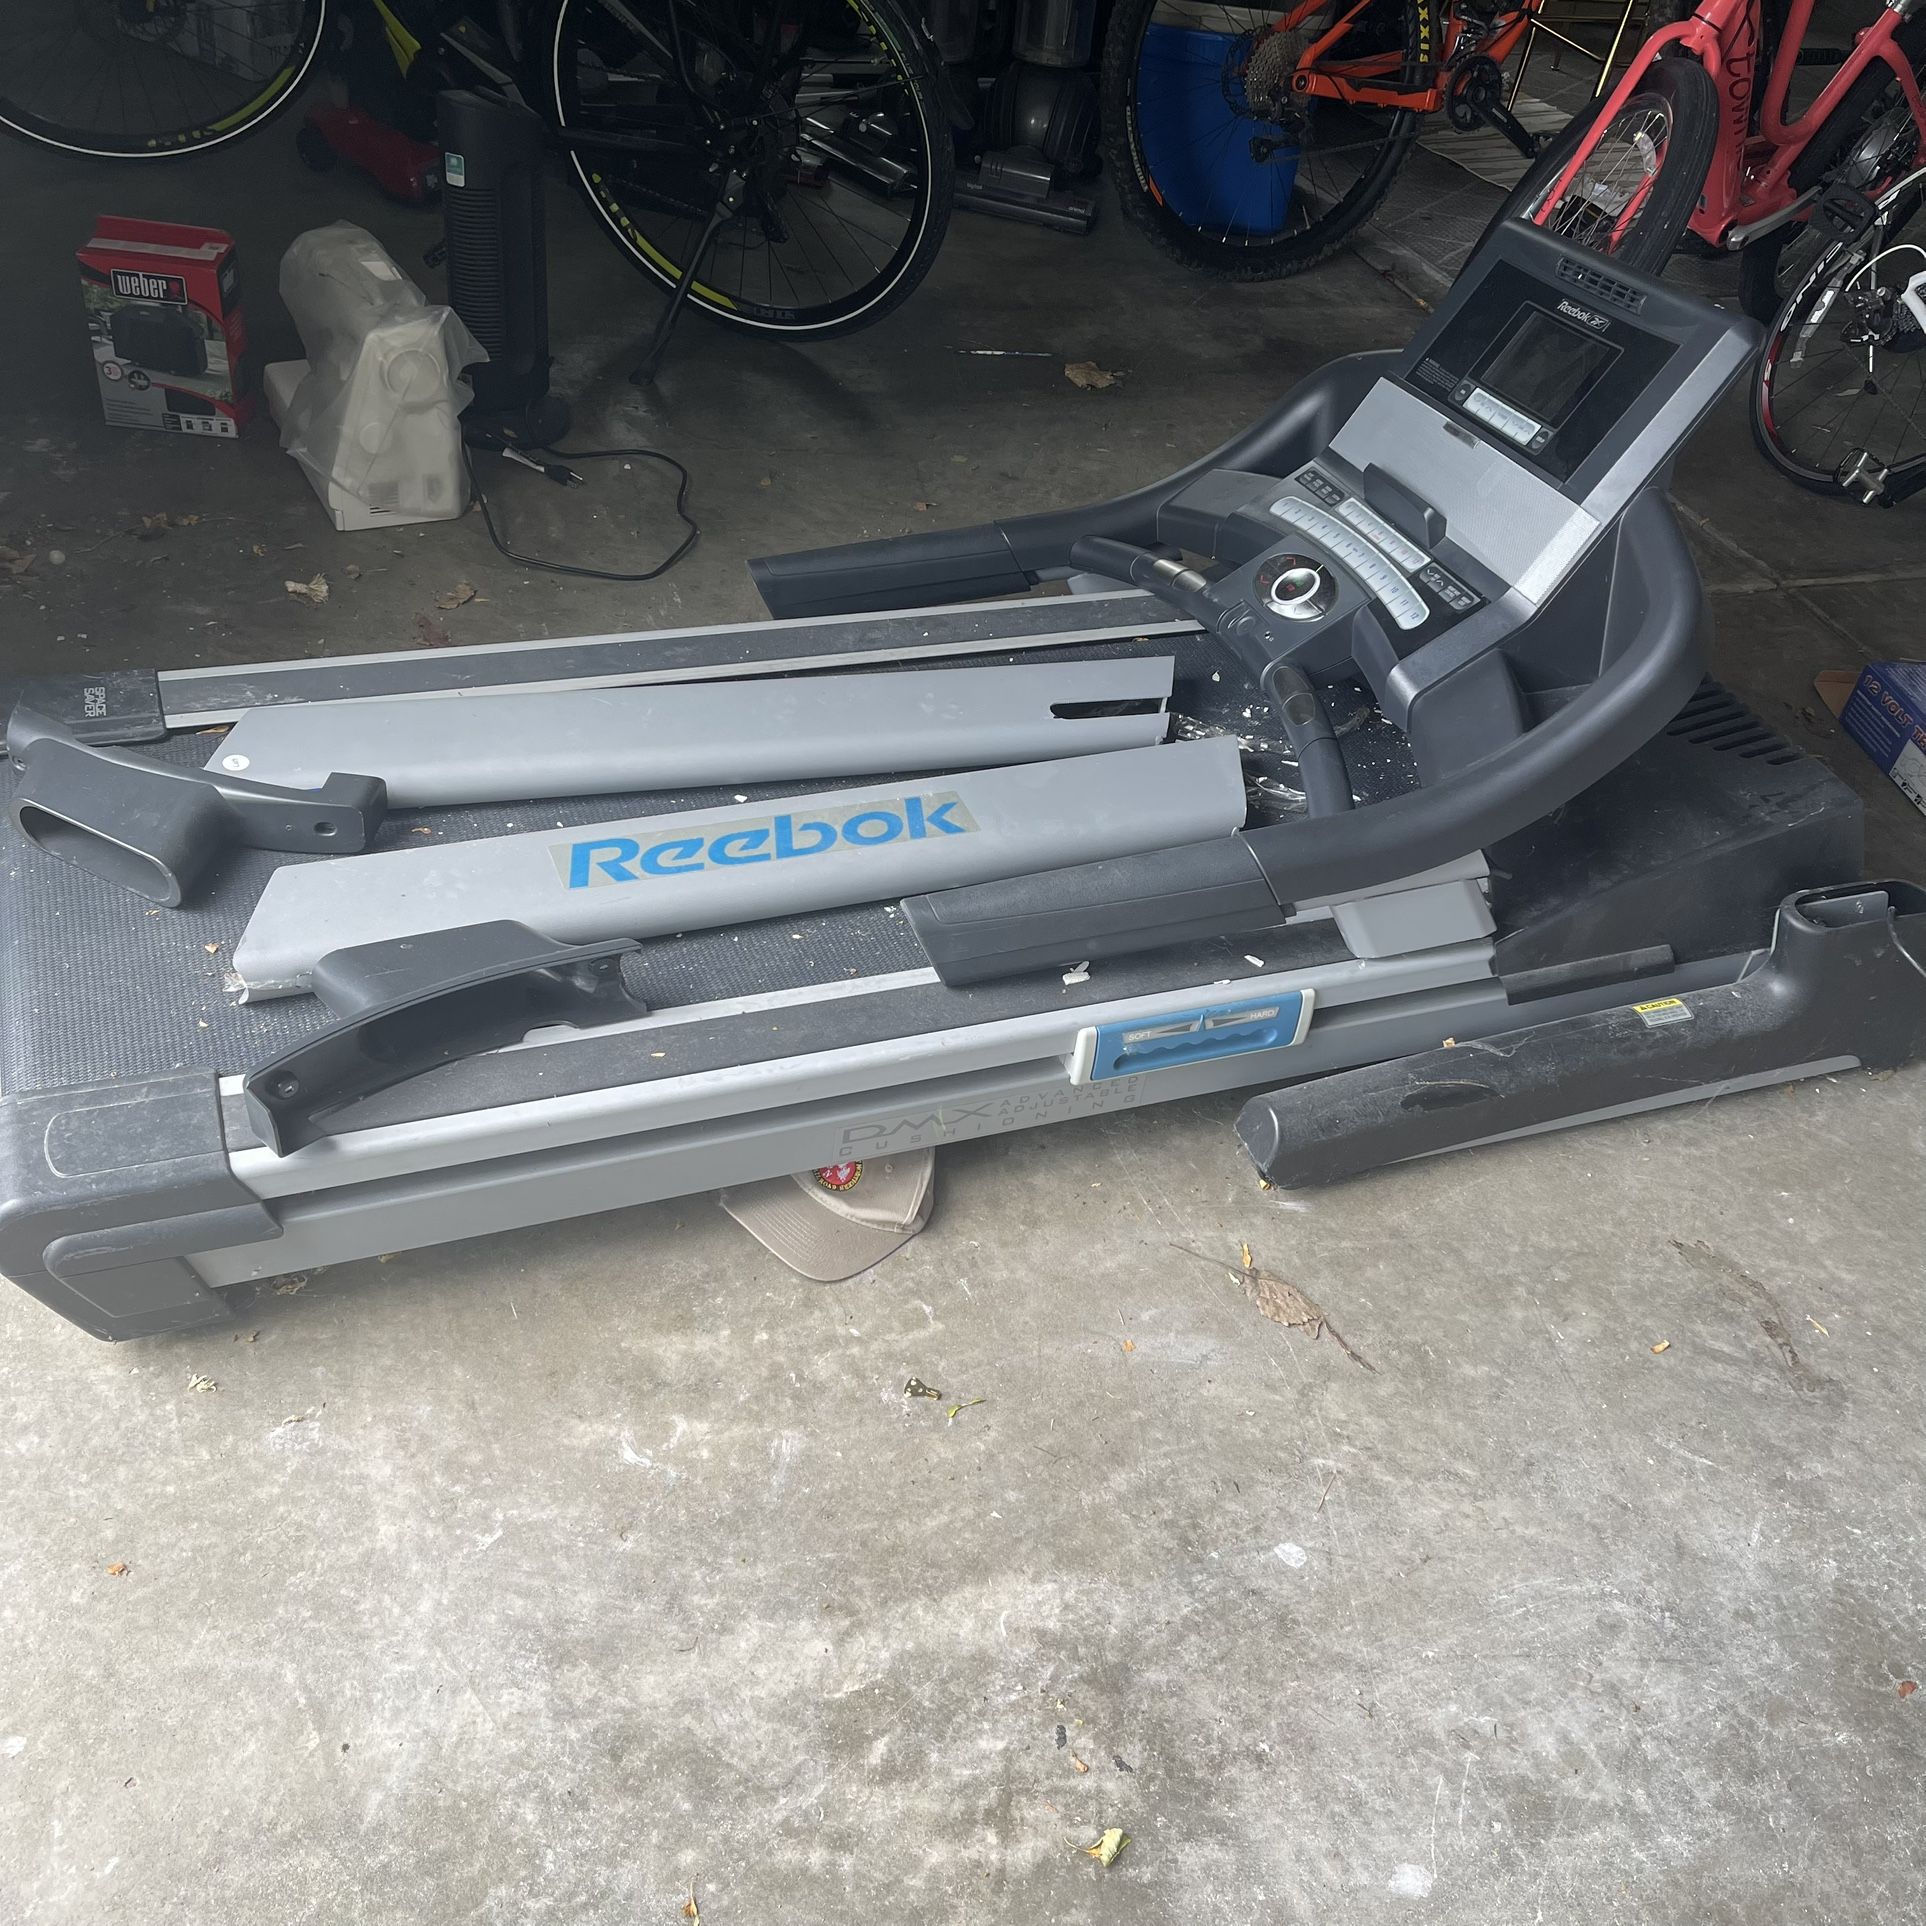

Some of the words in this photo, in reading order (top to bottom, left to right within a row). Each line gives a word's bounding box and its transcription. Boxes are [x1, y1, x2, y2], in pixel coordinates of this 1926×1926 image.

[1417, 0, 1430, 63] XXIS
[117, 271, 168, 300] weber
[1556, 300, 1592, 323] Reebok
[83, 687, 96, 718] SAVER
[94, 686, 107, 717] SPACE
[1863, 674, 1882, 696] 12
[1880, 690, 1914, 728] VOLT
[568, 795, 968, 889] Reebok
[1249, 1008, 1275, 1020] HARD
[1646, 1000, 1677, 1009] CAUTION
[1127, 1030, 1152, 1042] SOFT
[1000, 1076, 1138, 1107] ADVANCED
[1000, 1085, 1137, 1116] ADJUSTABLE
[839, 1094, 1136, 1156] CUSHIONING
[842, 1102, 994, 1144] DMX
